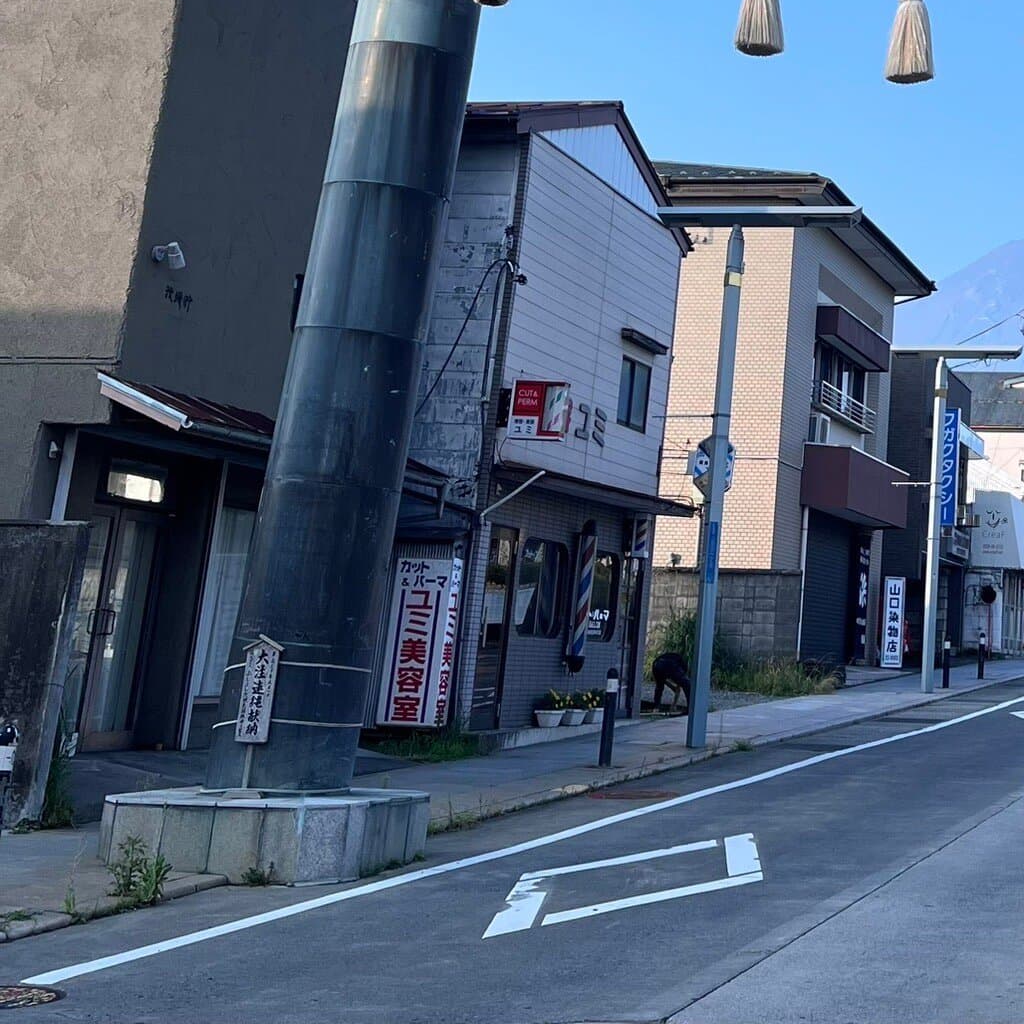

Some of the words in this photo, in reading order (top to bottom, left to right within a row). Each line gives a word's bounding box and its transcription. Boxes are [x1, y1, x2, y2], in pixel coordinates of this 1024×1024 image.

[517, 398, 538, 406] PERM
[886, 583, 901, 653] 山口染物店
[390, 589, 433, 723] ユミ美容室
